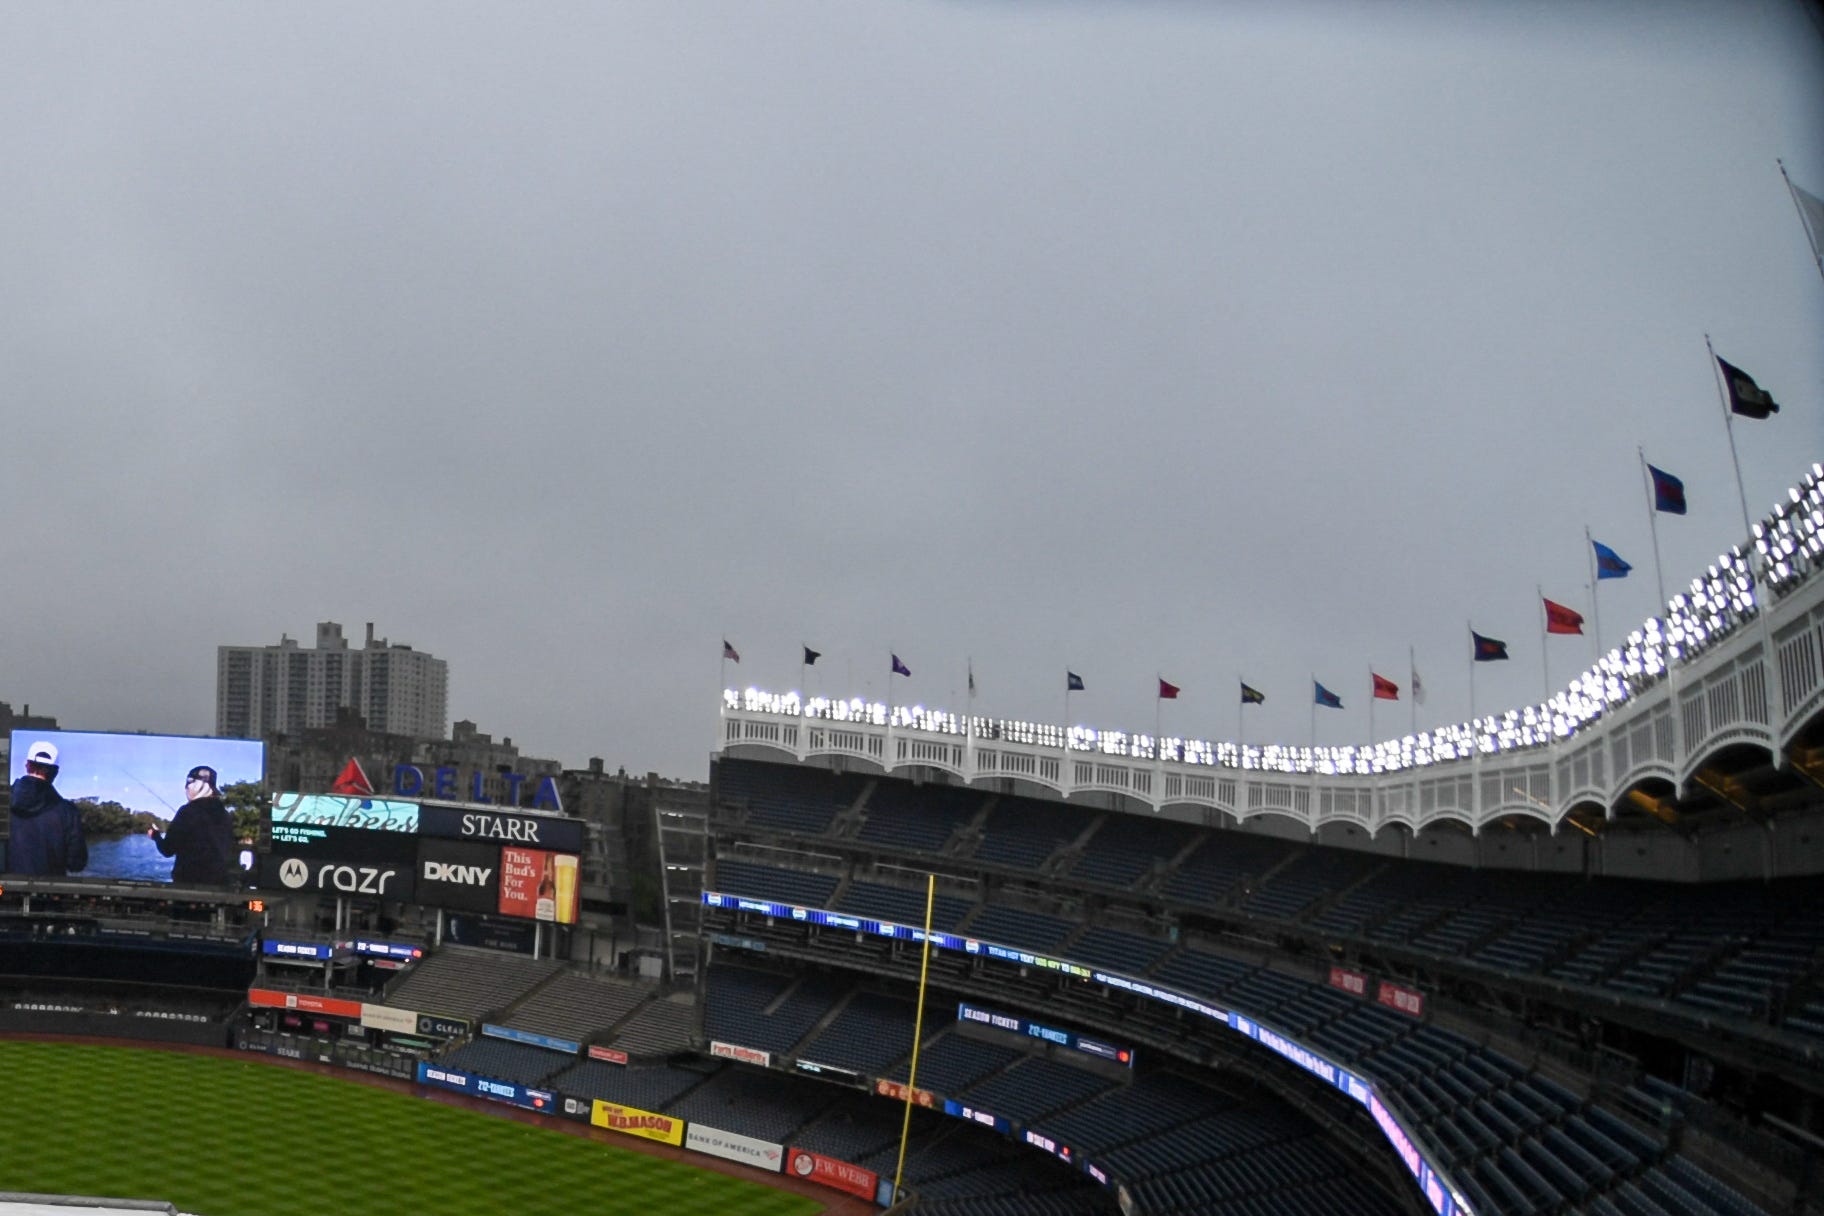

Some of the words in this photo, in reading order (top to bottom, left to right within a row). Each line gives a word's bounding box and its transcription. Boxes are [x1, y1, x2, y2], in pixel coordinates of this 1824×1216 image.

[394, 764, 563, 810] DELTA
[461, 814, 540, 843] STARR
[505, 851, 531, 864] This
[318, 864, 396, 895] razr
[424, 861, 492, 887] DKNY
[505, 863, 536, 877] Bud's
[505, 875, 524, 888] For
[504, 887, 528, 900] You.
[688, 1132, 711, 1144] BANK
[712, 1137, 722, 1146] OF
[724, 1140, 761, 1157] AMERICA
[837, 1166, 869, 1187] WEBB
